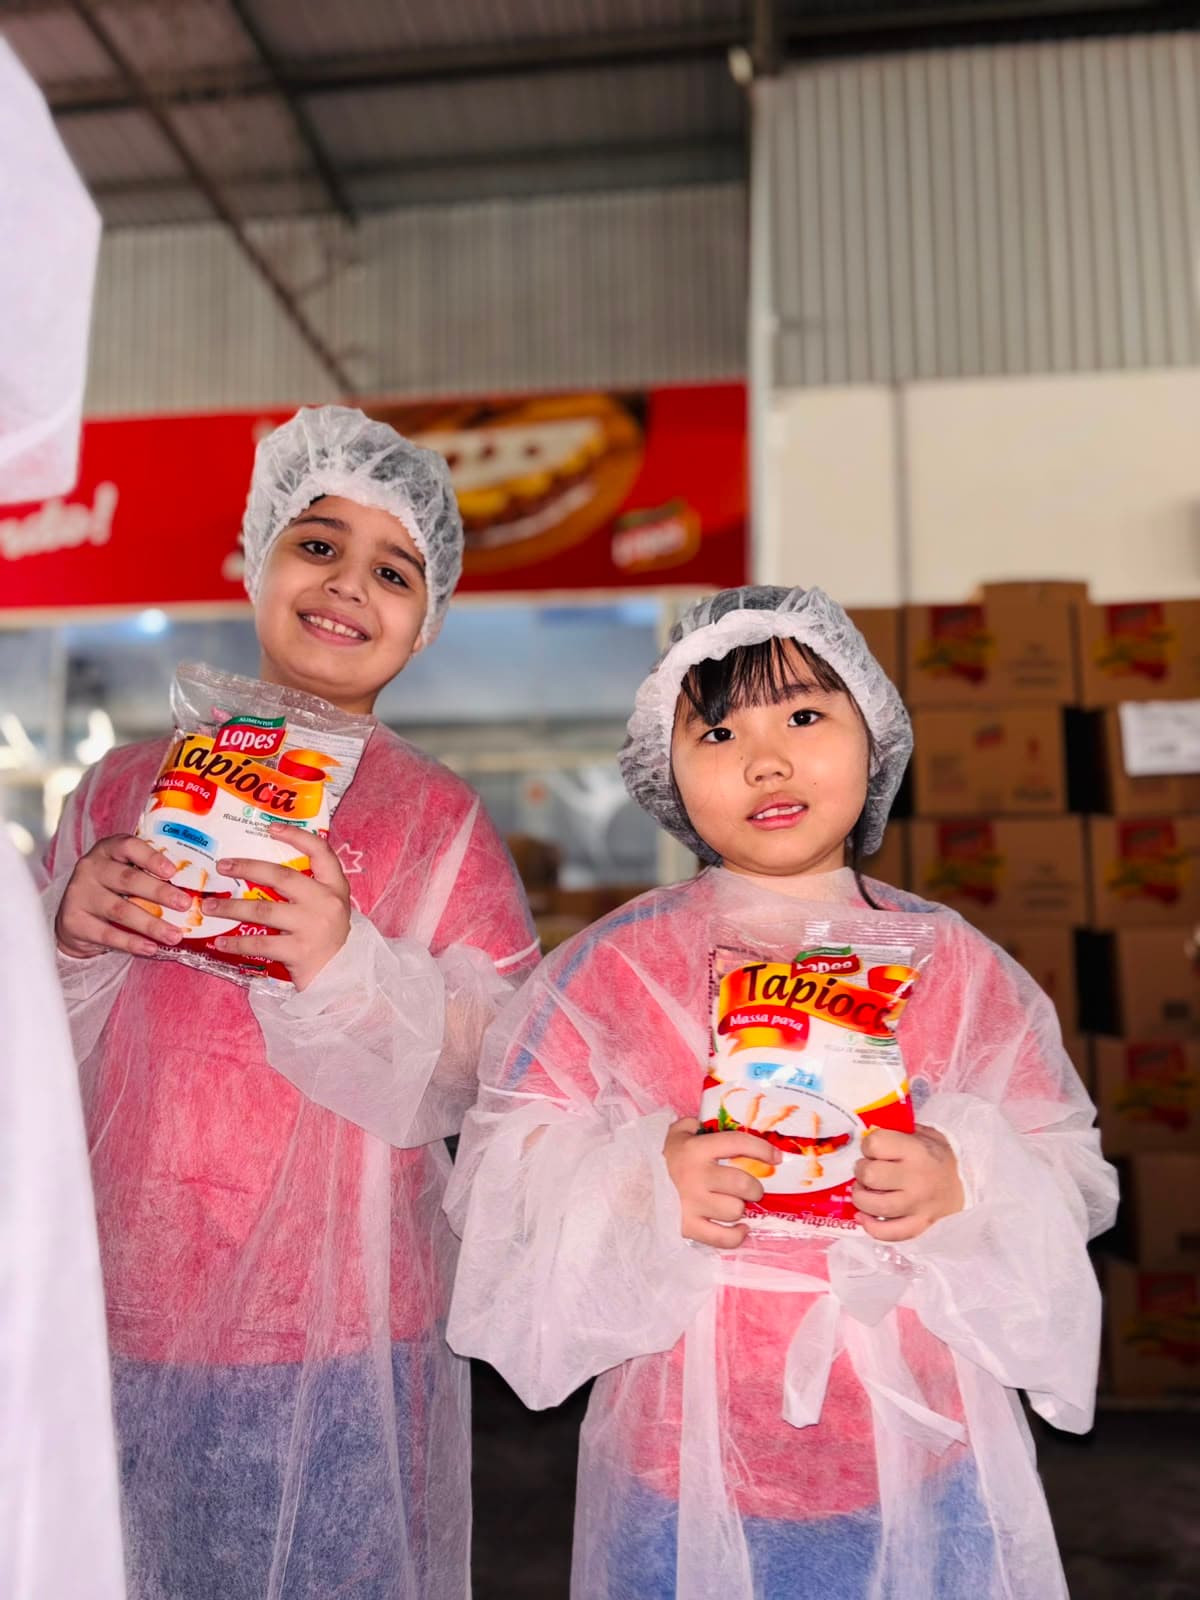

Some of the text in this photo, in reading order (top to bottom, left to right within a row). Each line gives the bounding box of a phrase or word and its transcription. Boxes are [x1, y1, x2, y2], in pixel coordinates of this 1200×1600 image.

[219, 729, 277, 751] Lopes
[173, 735, 298, 813] Tapioca
[186, 782, 211, 800] para
[162, 824, 180, 835] Com
[730, 1014, 804, 1031] Massa para
